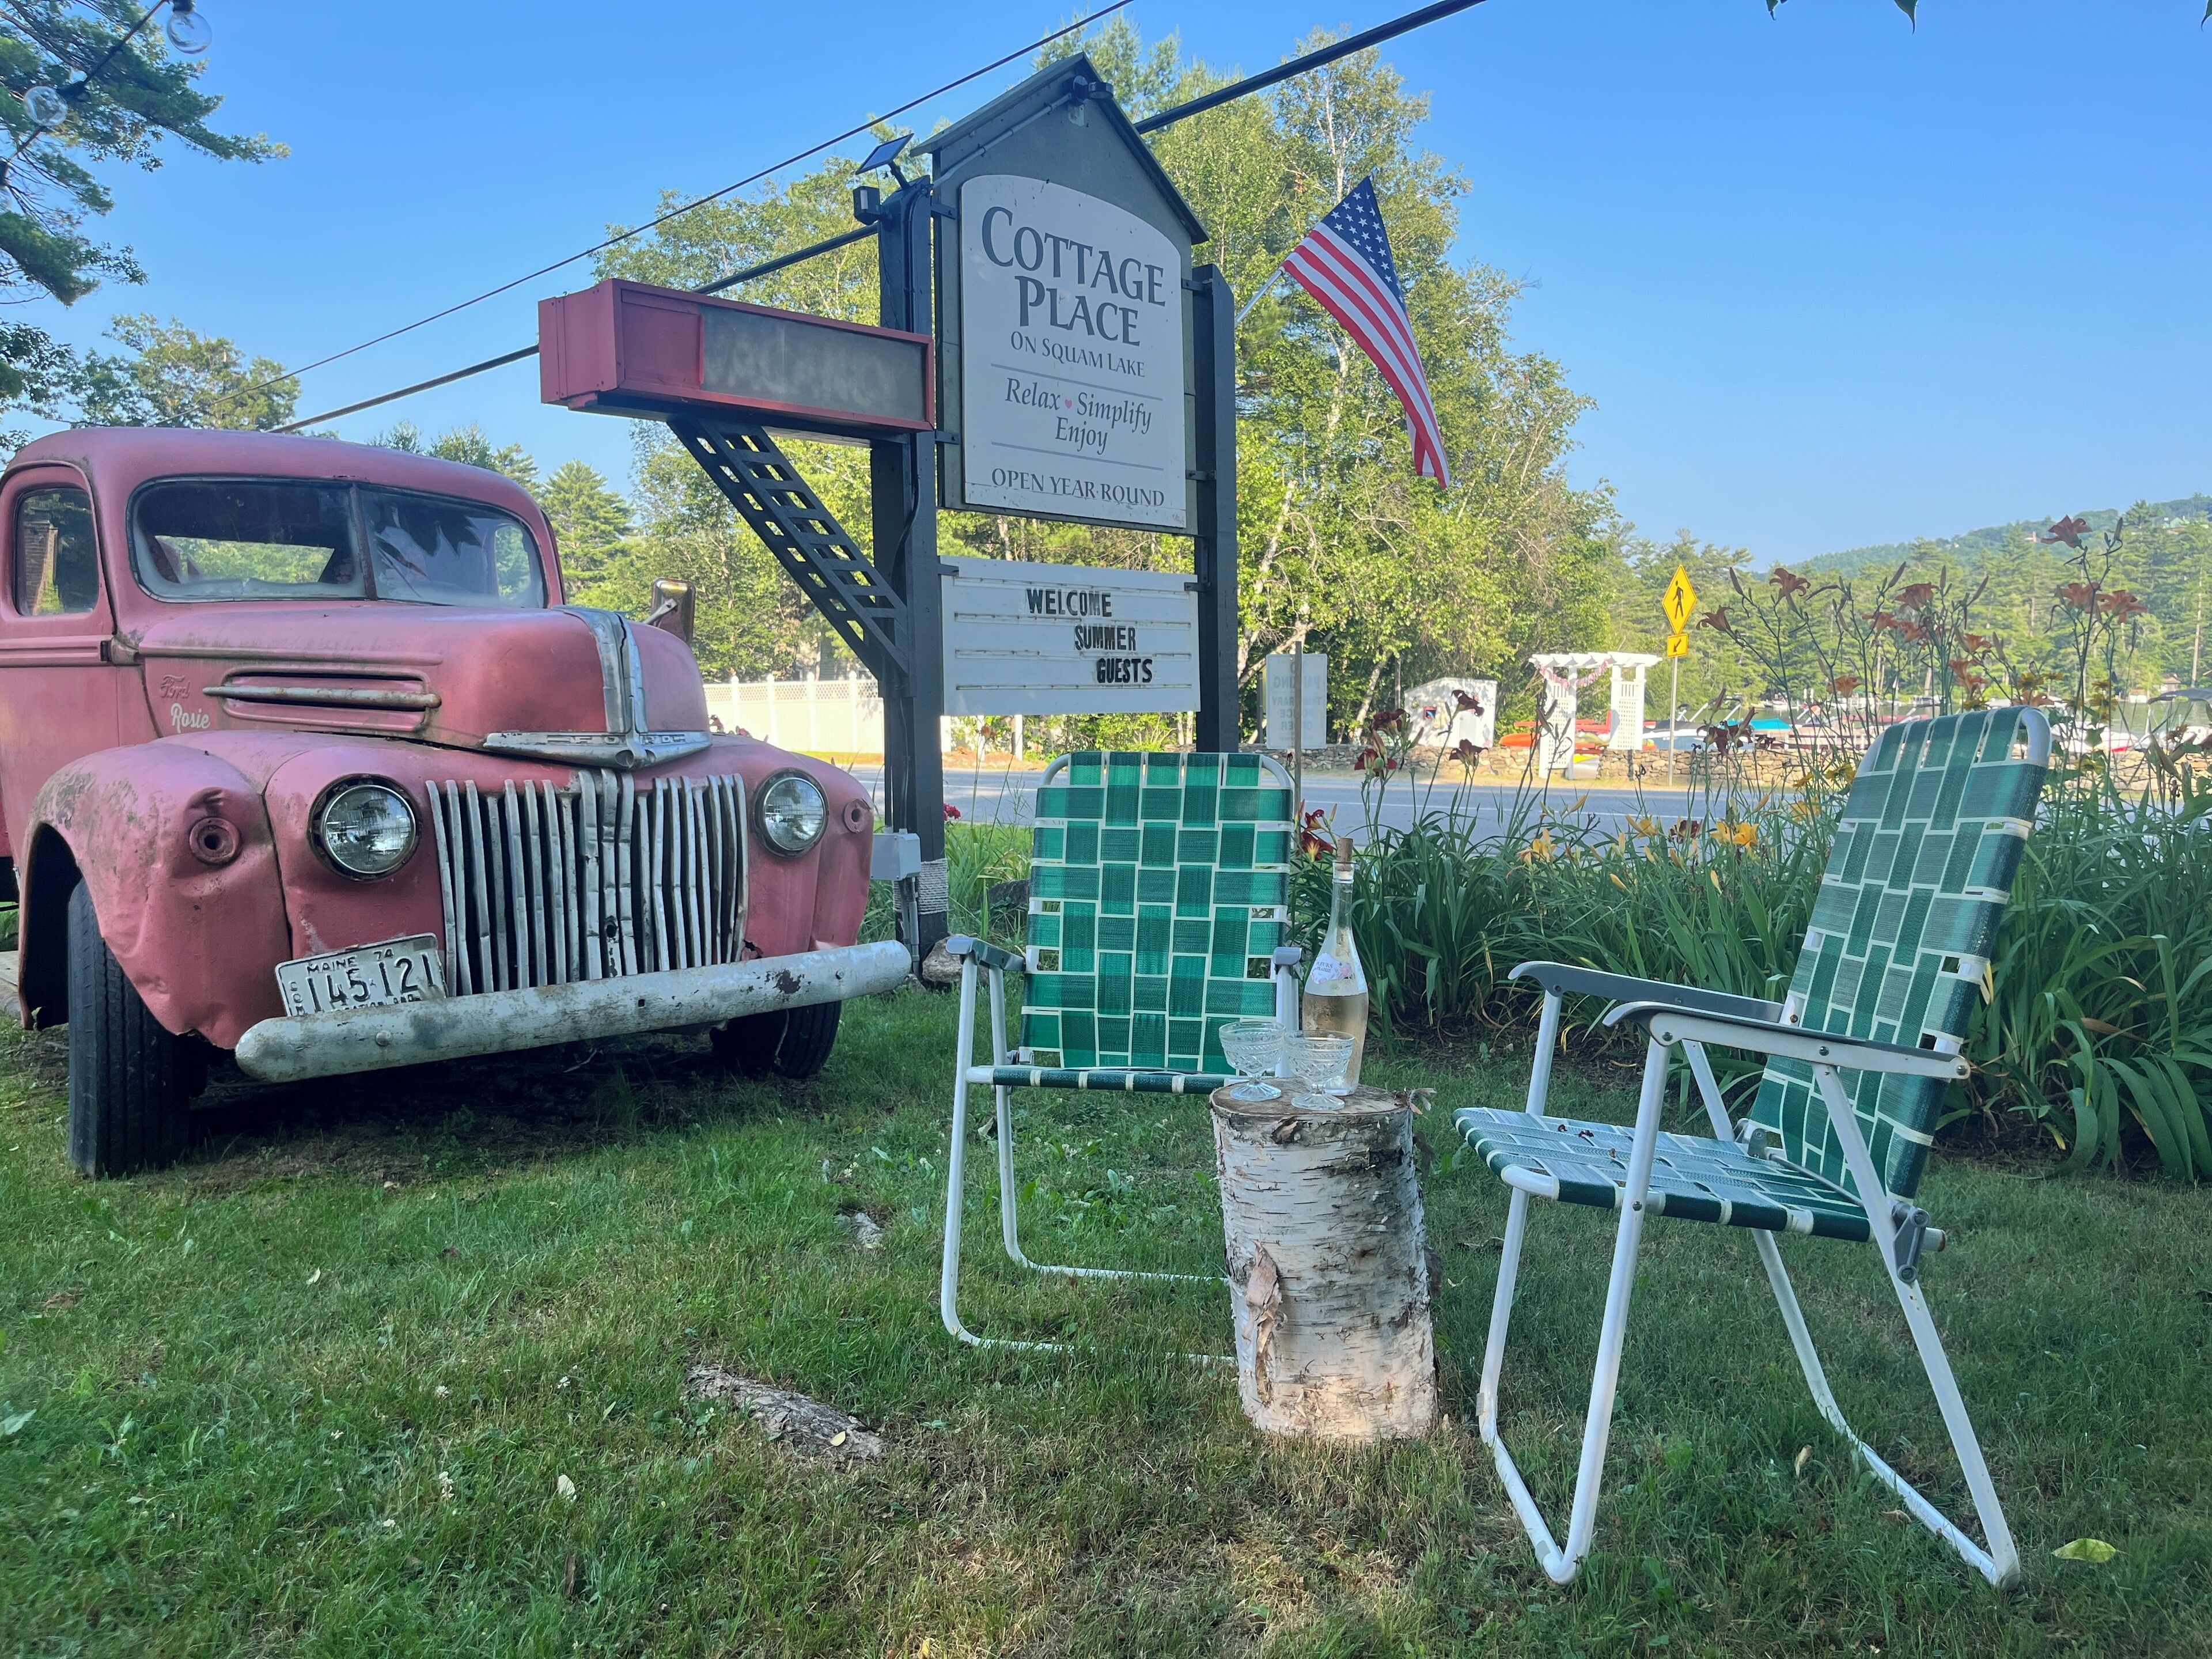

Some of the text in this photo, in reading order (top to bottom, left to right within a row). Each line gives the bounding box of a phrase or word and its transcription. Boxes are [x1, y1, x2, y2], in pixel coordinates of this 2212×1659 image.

[982, 206, 1166, 307] COTTAGE
[1014, 275, 1141, 347] PLACE
[1011, 331, 1146, 378] ON SQUAM LAKE
[1005, 377, 1152, 435] Relax Simplify
[1055, 416, 1108, 455] Enjoy
[991, 468, 1165, 507] OPEN YEAR ROUND
[1026, 588, 1113, 618] WELCOME
[1074, 624, 1137, 652] SUMMER
[1096, 658, 1153, 684] GUESTS
[171, 702, 211, 733] Rosie
[306, 956, 358, 975] MAINE
